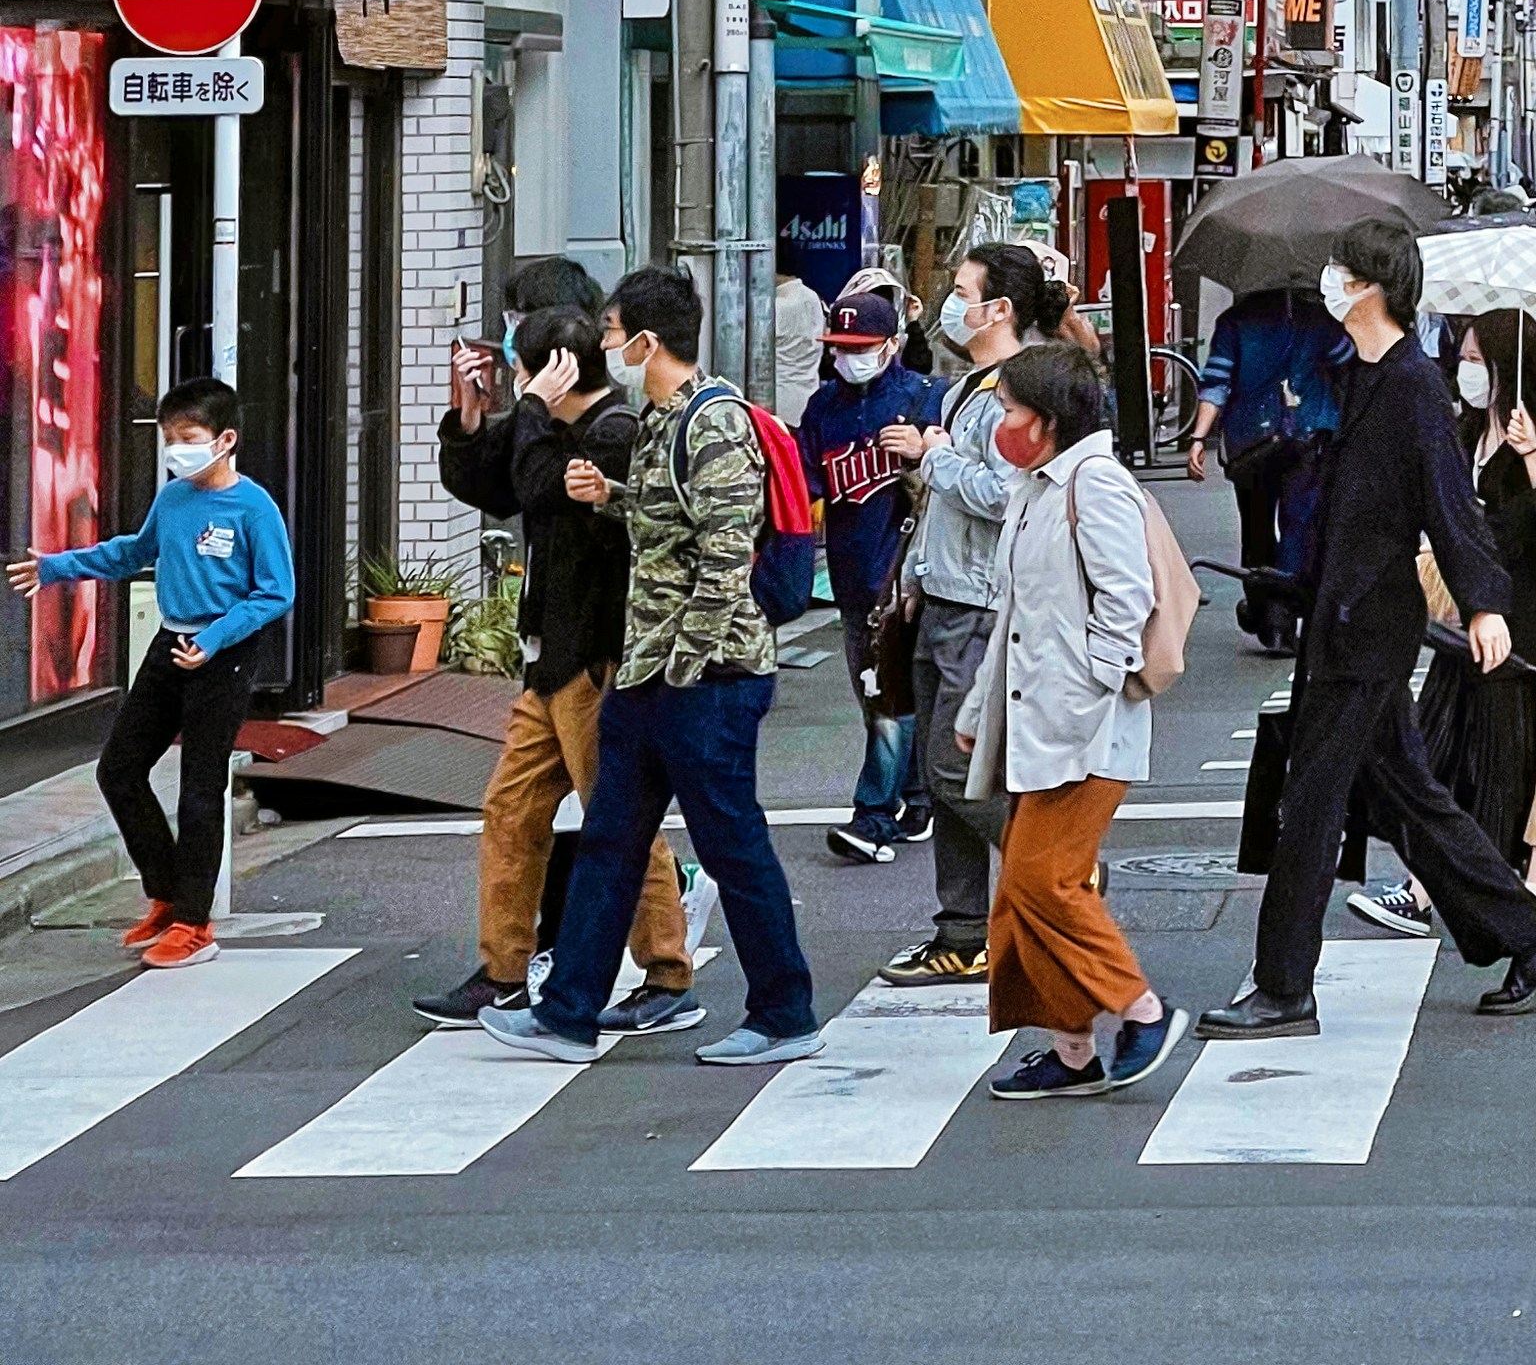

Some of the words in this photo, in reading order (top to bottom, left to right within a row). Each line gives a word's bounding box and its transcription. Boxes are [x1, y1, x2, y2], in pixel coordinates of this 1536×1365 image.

[123, 71, 250, 103] 自転車を除く
[780, 213, 848, 241] Asahi
[838, 307, 858, 330] T
[821, 440, 902, 505] Twin
